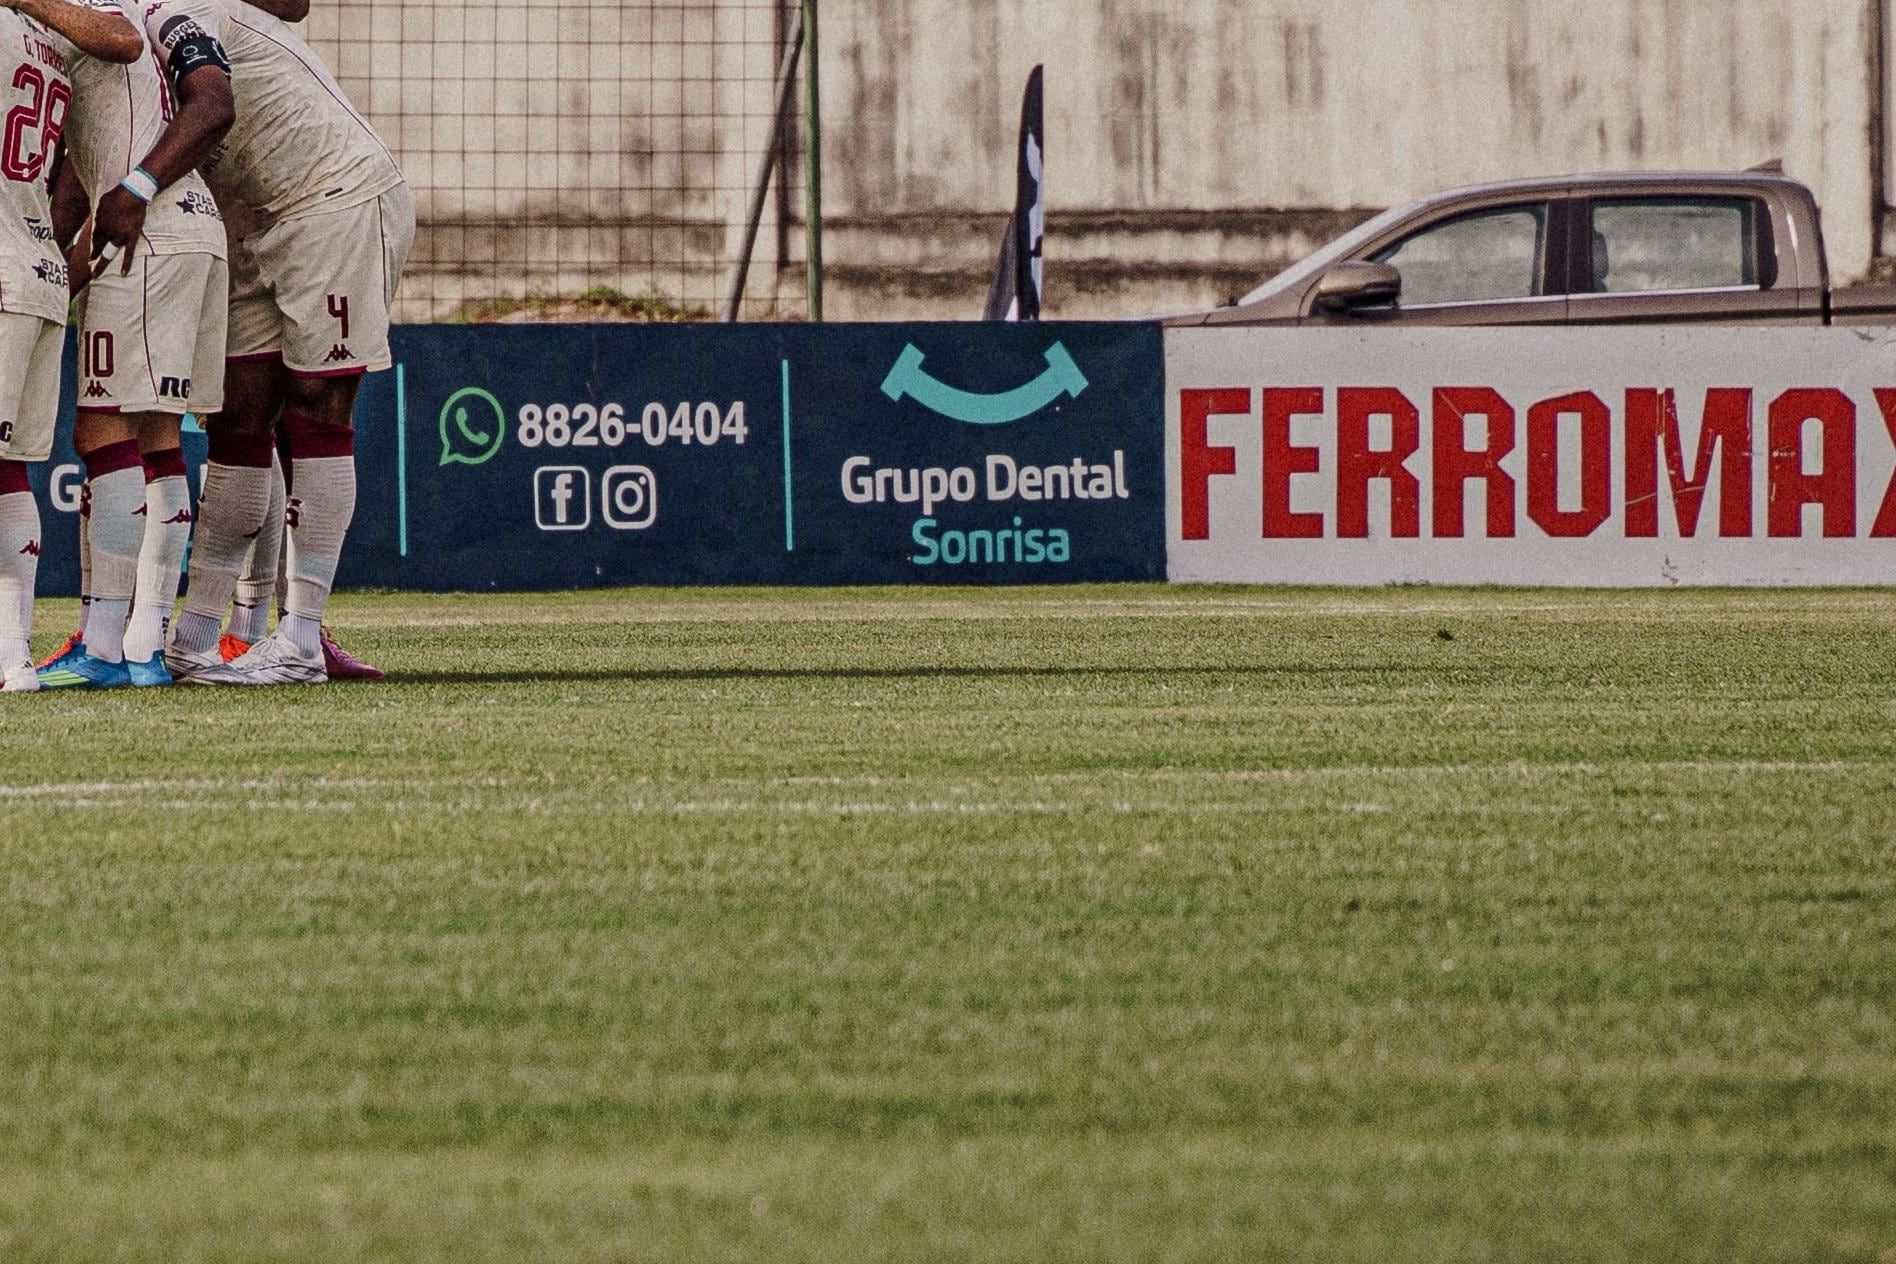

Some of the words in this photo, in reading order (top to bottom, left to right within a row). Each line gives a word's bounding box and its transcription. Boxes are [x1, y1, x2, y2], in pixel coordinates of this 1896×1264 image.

[326, 293, 350, 339] 4
[83, 330, 115, 378] 10
[517, 401, 748, 447] 8826-0404
[841, 456, 976, 516] Grupo
[985, 450, 1129, 500] Dental
[912, 516, 1070, 565] Sonrisa
